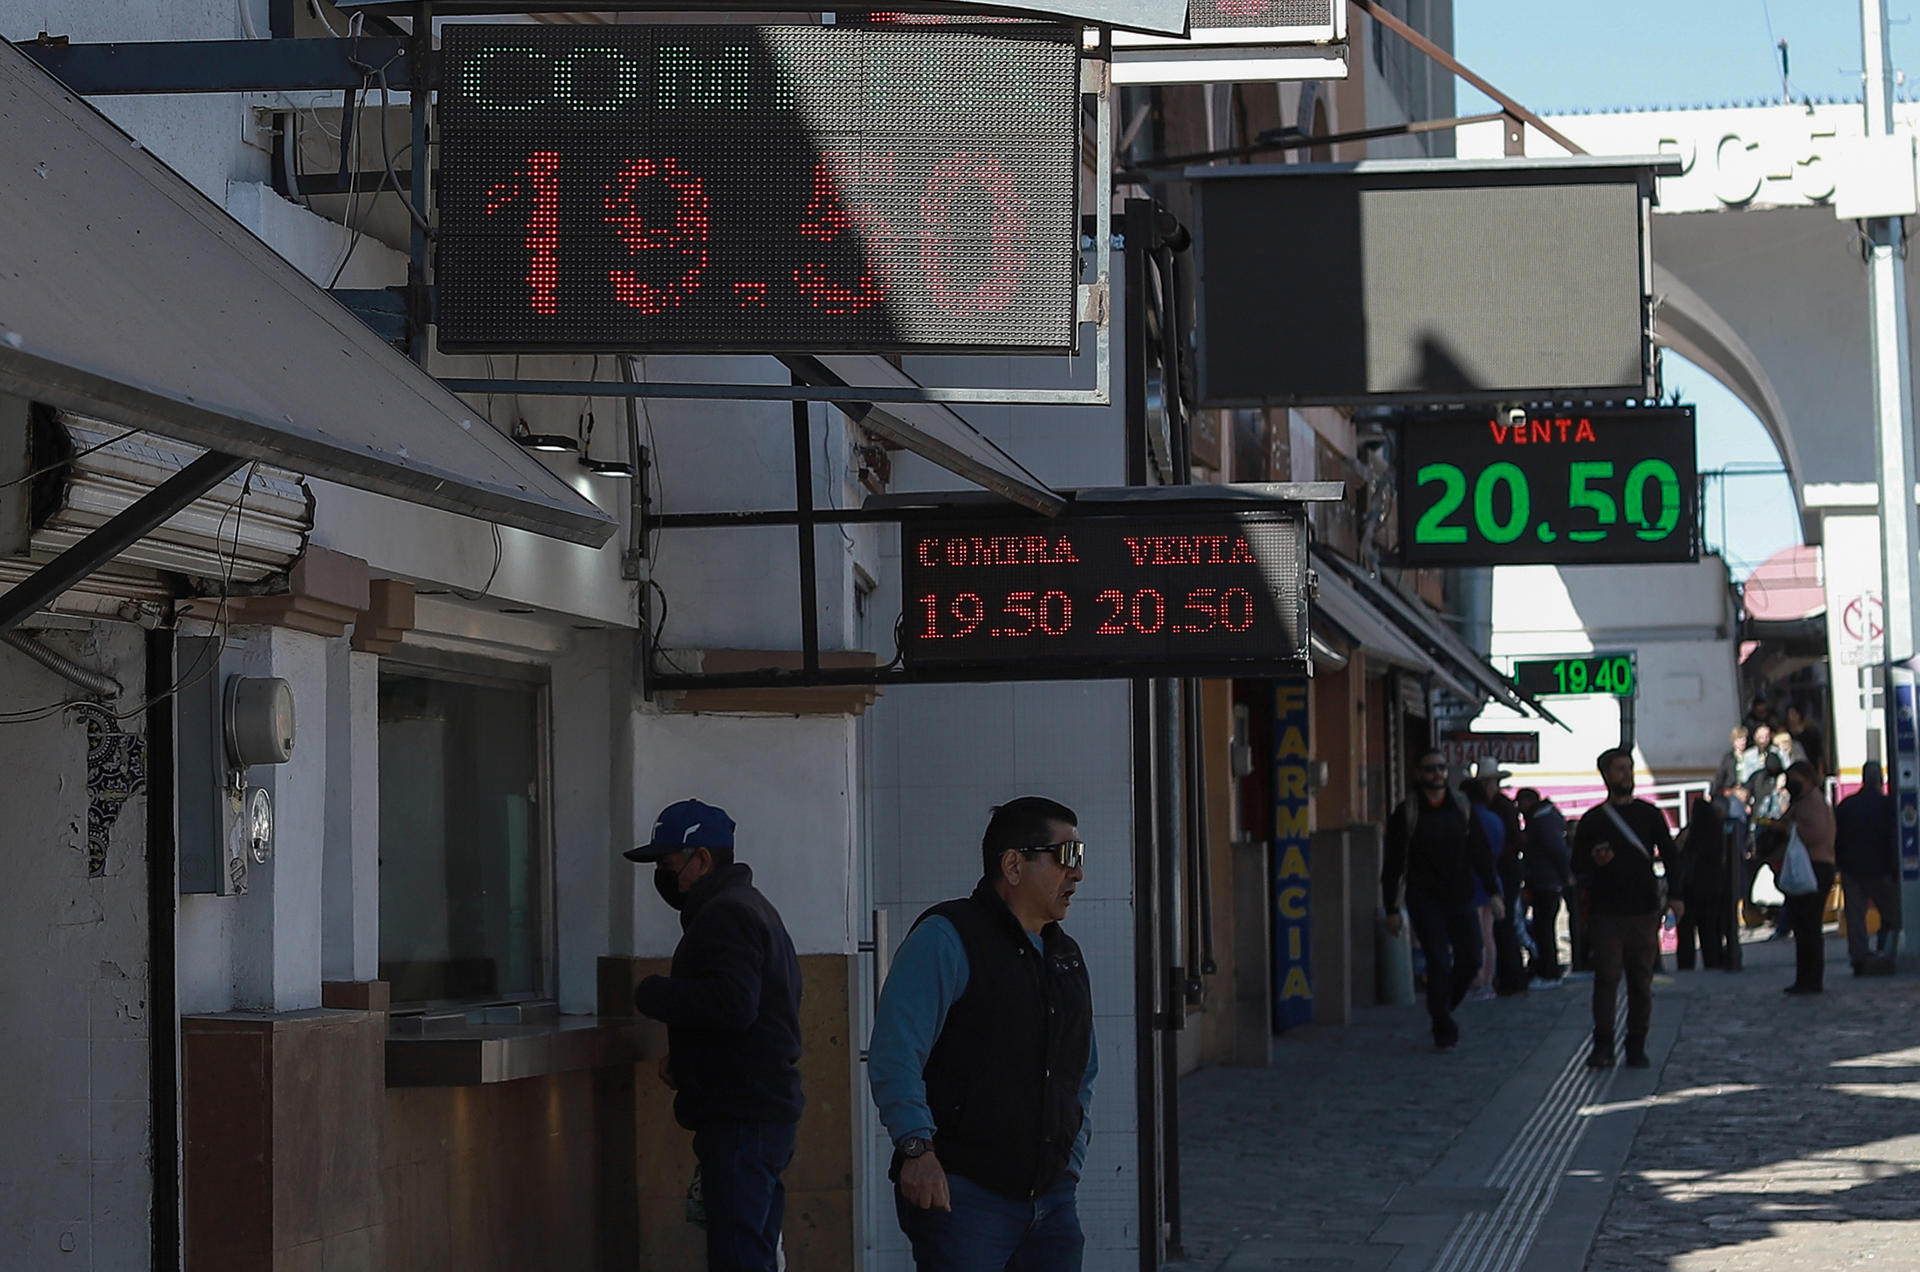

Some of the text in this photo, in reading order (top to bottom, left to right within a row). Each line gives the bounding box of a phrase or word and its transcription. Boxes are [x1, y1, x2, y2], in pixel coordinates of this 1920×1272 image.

[1490, 418, 1596, 444] VENTA
[1415, 459, 1681, 543] 20.50
[918, 535, 1258, 566] COMPRA VENTA
[918, 587, 1255, 639] 19.50 20.50
[1552, 657, 1632, 693] 19.40
[1276, 686, 1314, 1000] FARMACIA
